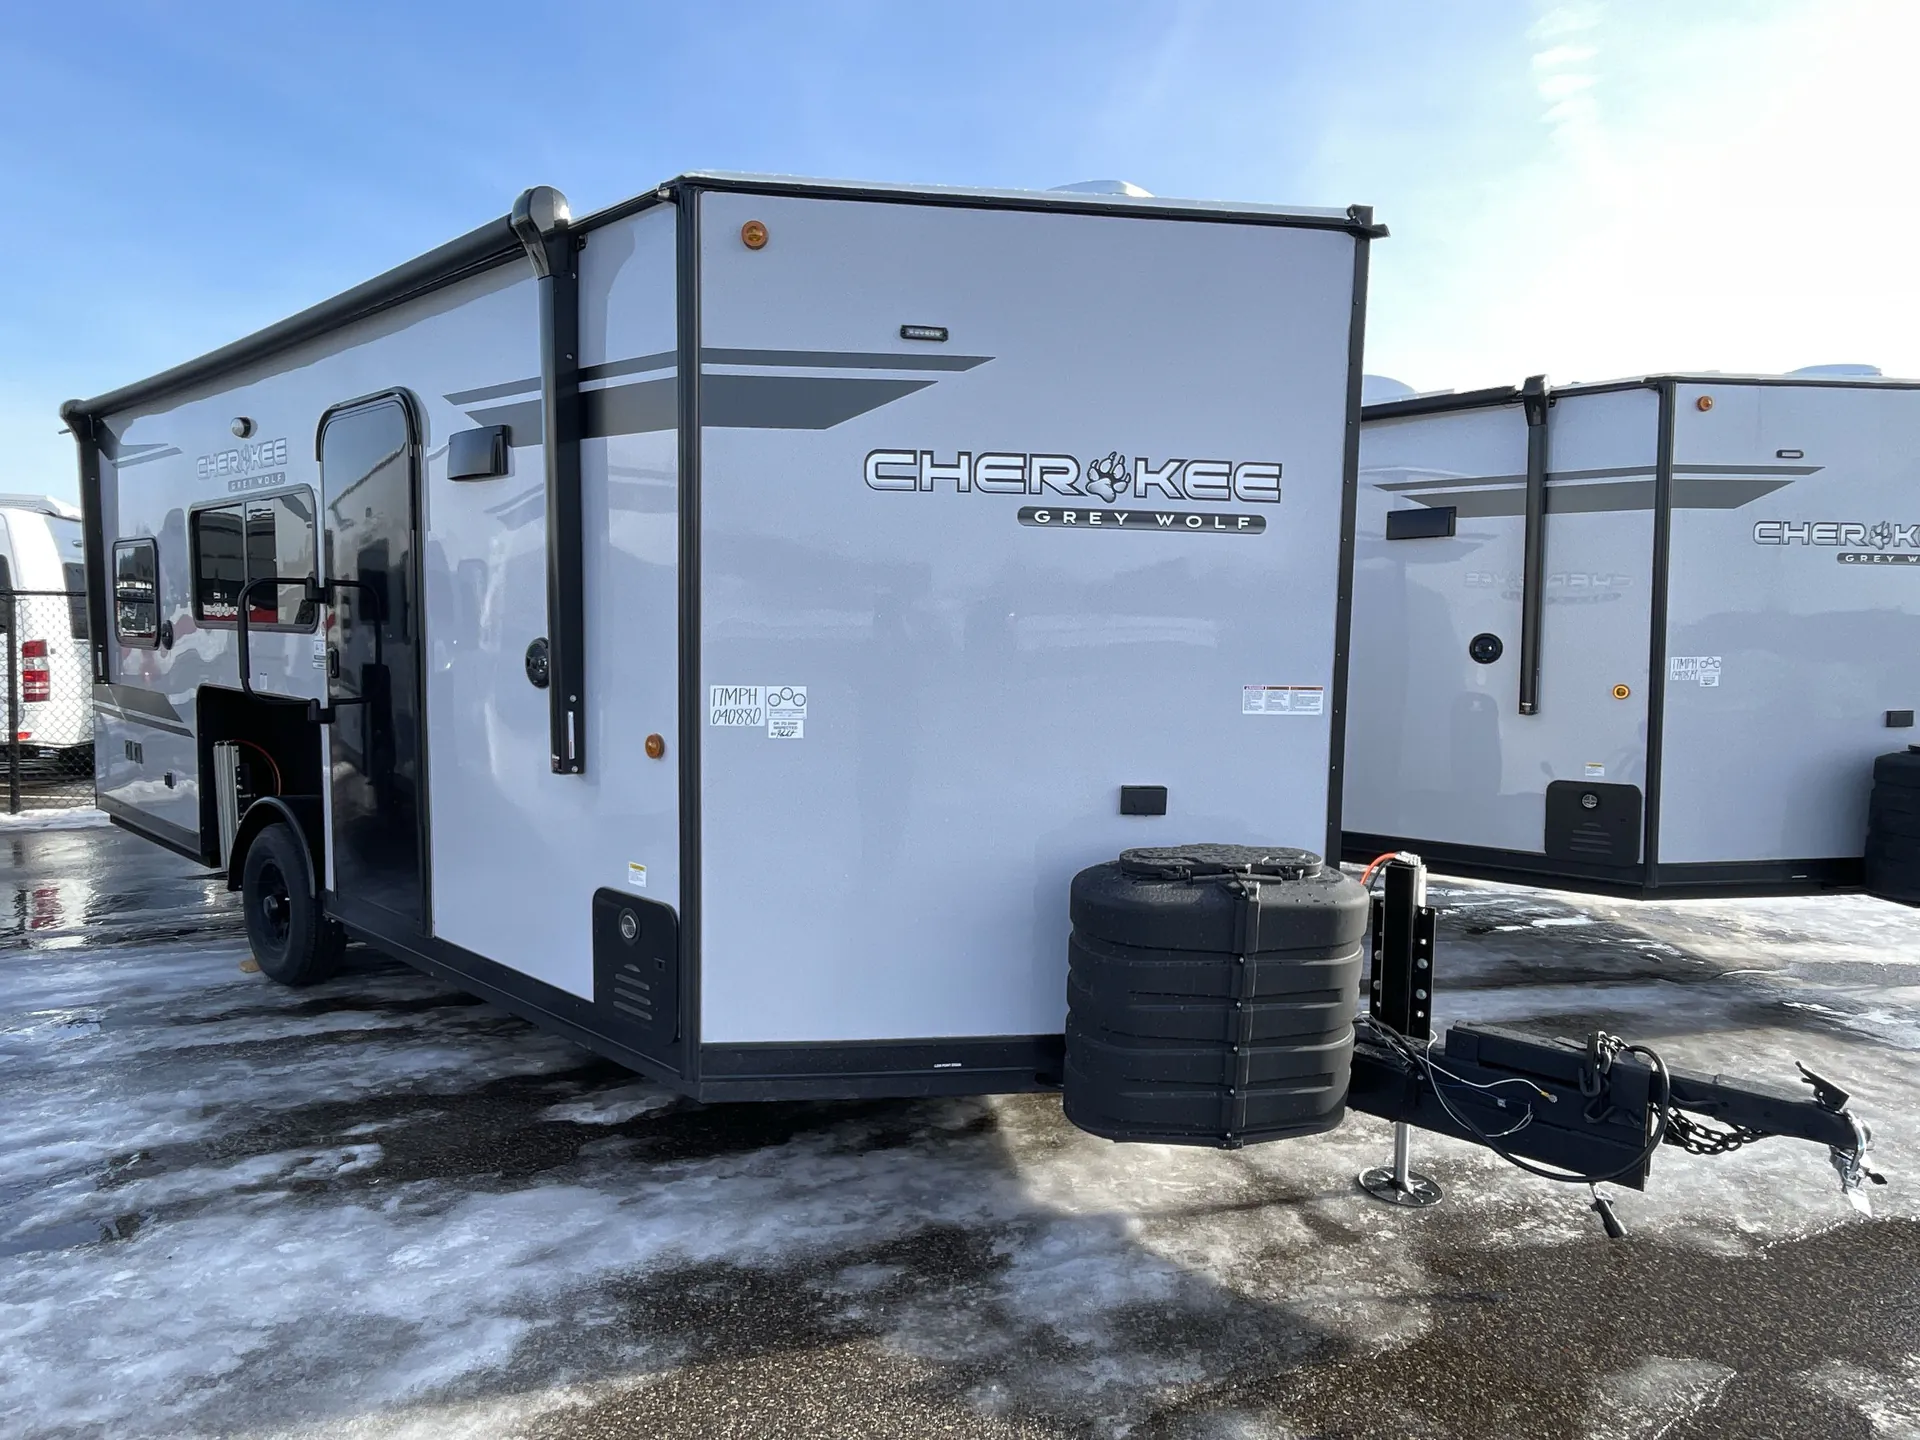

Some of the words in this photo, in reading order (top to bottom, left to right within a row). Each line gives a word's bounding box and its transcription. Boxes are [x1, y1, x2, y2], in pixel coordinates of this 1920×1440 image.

[1034, 510, 1129, 526] GREY
[1155, 513, 1251, 530] WOLF
[1753, 521, 1920, 550] CHEROK
[1845, 555, 1895, 564] GREY
[1907, 555, 1919, 563] W
[712, 687, 757, 707] 17MPH
[712, 707, 762, 725] 040880
